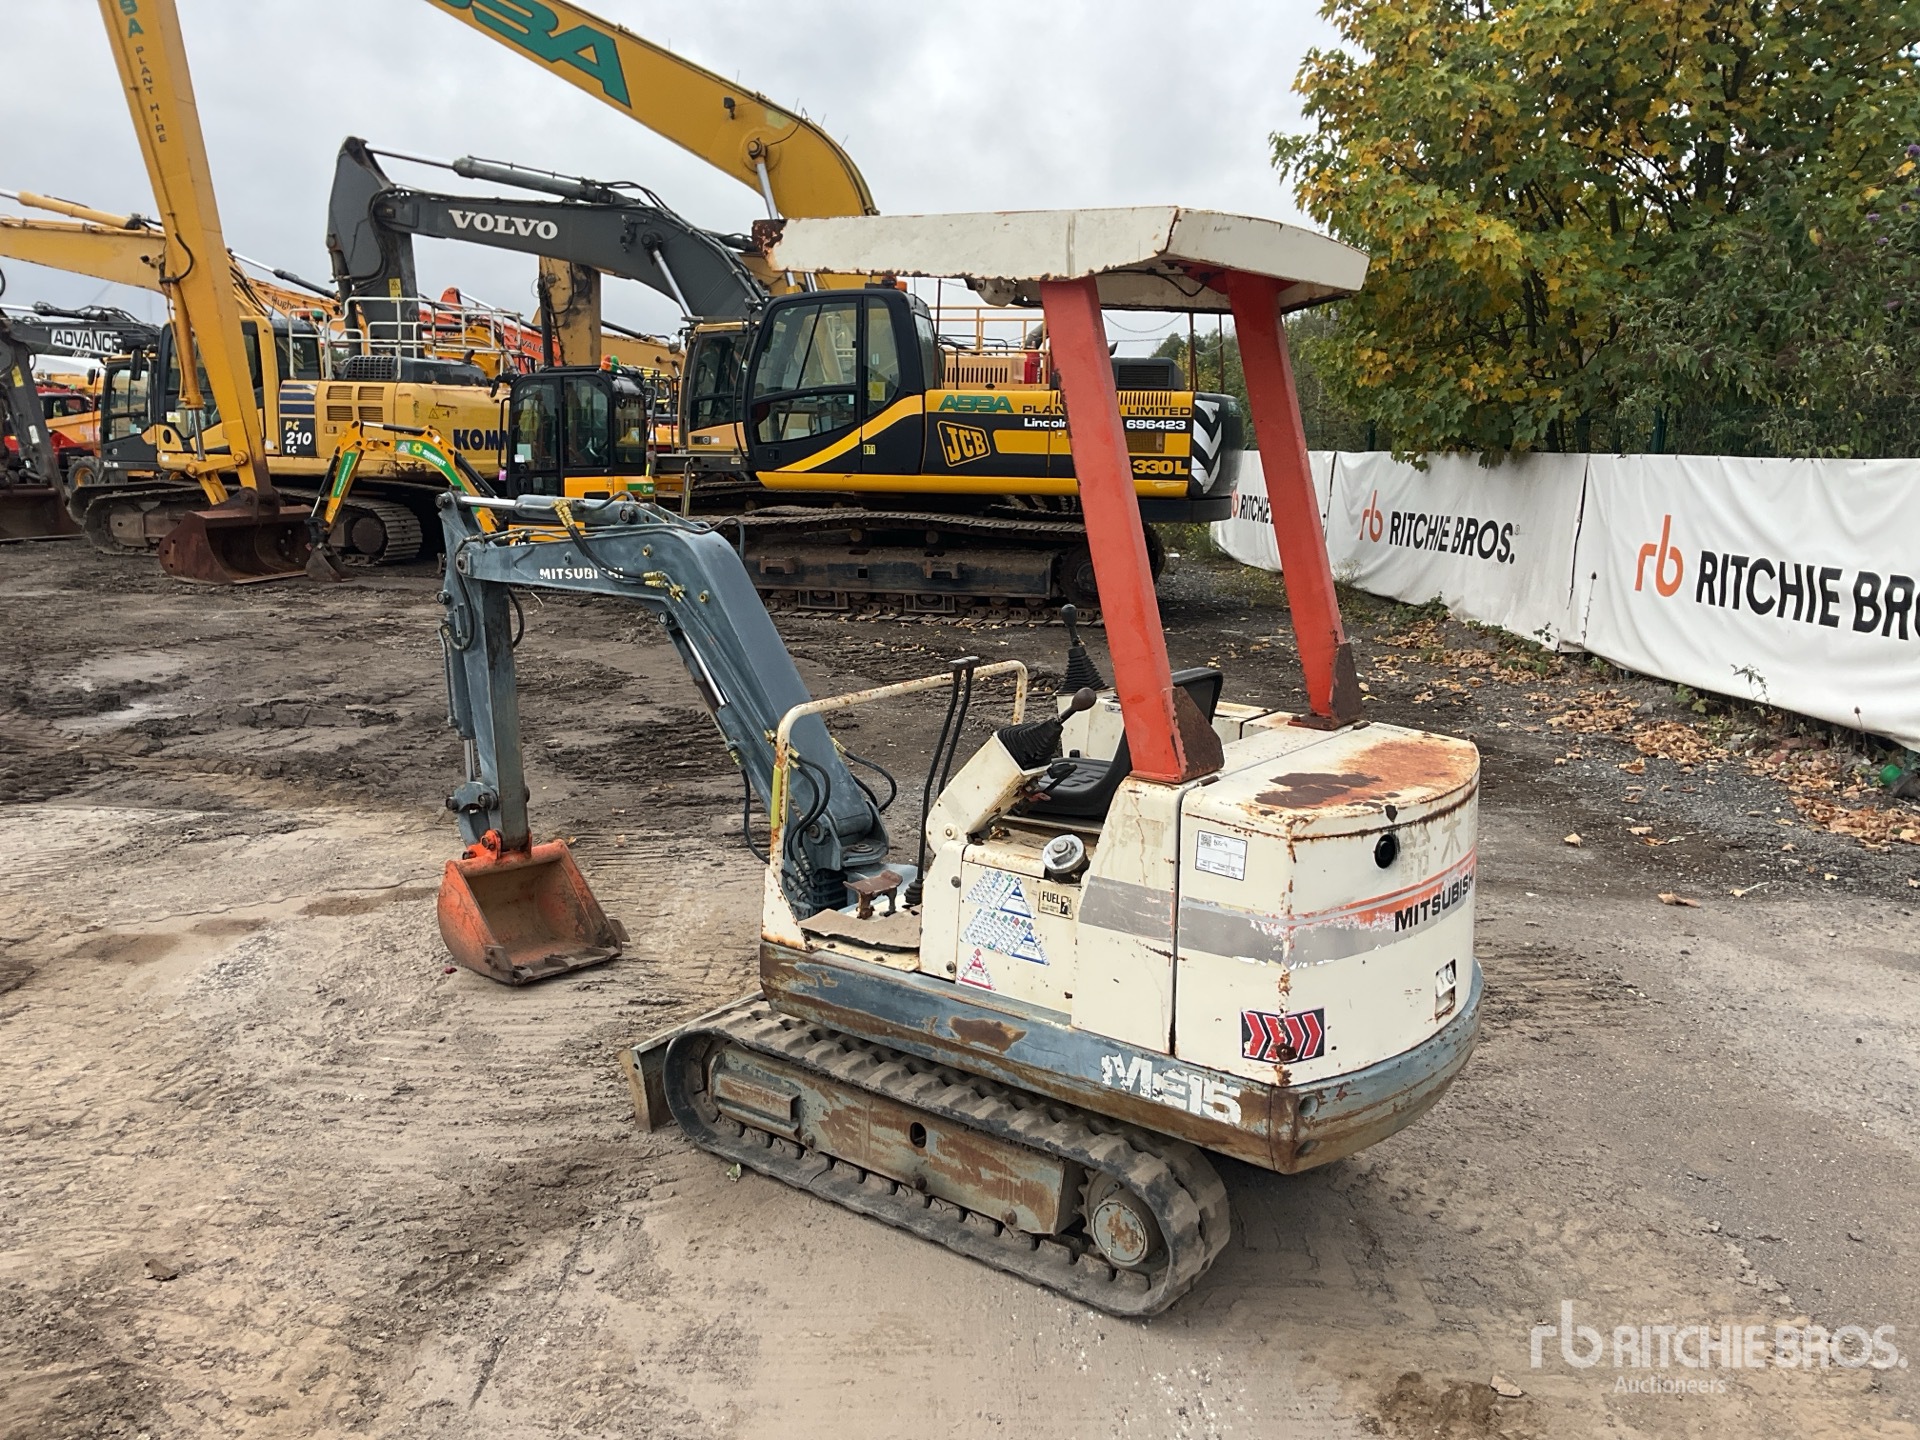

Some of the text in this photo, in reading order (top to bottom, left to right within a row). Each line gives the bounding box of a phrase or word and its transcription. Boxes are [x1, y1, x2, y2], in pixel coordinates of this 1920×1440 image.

[136, 46, 153, 94] PLANT
[150, 103, 167, 142] HIRE
[448, 209, 558, 239] VOLVO
[272, 295, 300, 310] Hughe
[54, 330, 122, 354] ADVANCE
[938, 395, 1014, 413] ABBA
[1127, 407, 1191, 416] LIMITED
[285, 421, 300, 431] PC
[1126, 420, 1186, 430] 696423
[285, 432, 312, 445] 210
[945, 426, 987, 463] JCB
[286, 446, 297, 454] LC
[1239, 494, 1270, 524] RITCHIE
[1359, 490, 1383, 542] rb
[1389, 511, 1451, 552] RITCHIE
[540, 567, 624, 580] MITSUBII
[1635, 515, 1920, 641] rb RITCHIE BR
[1041, 890, 1060, 905] FUEL
